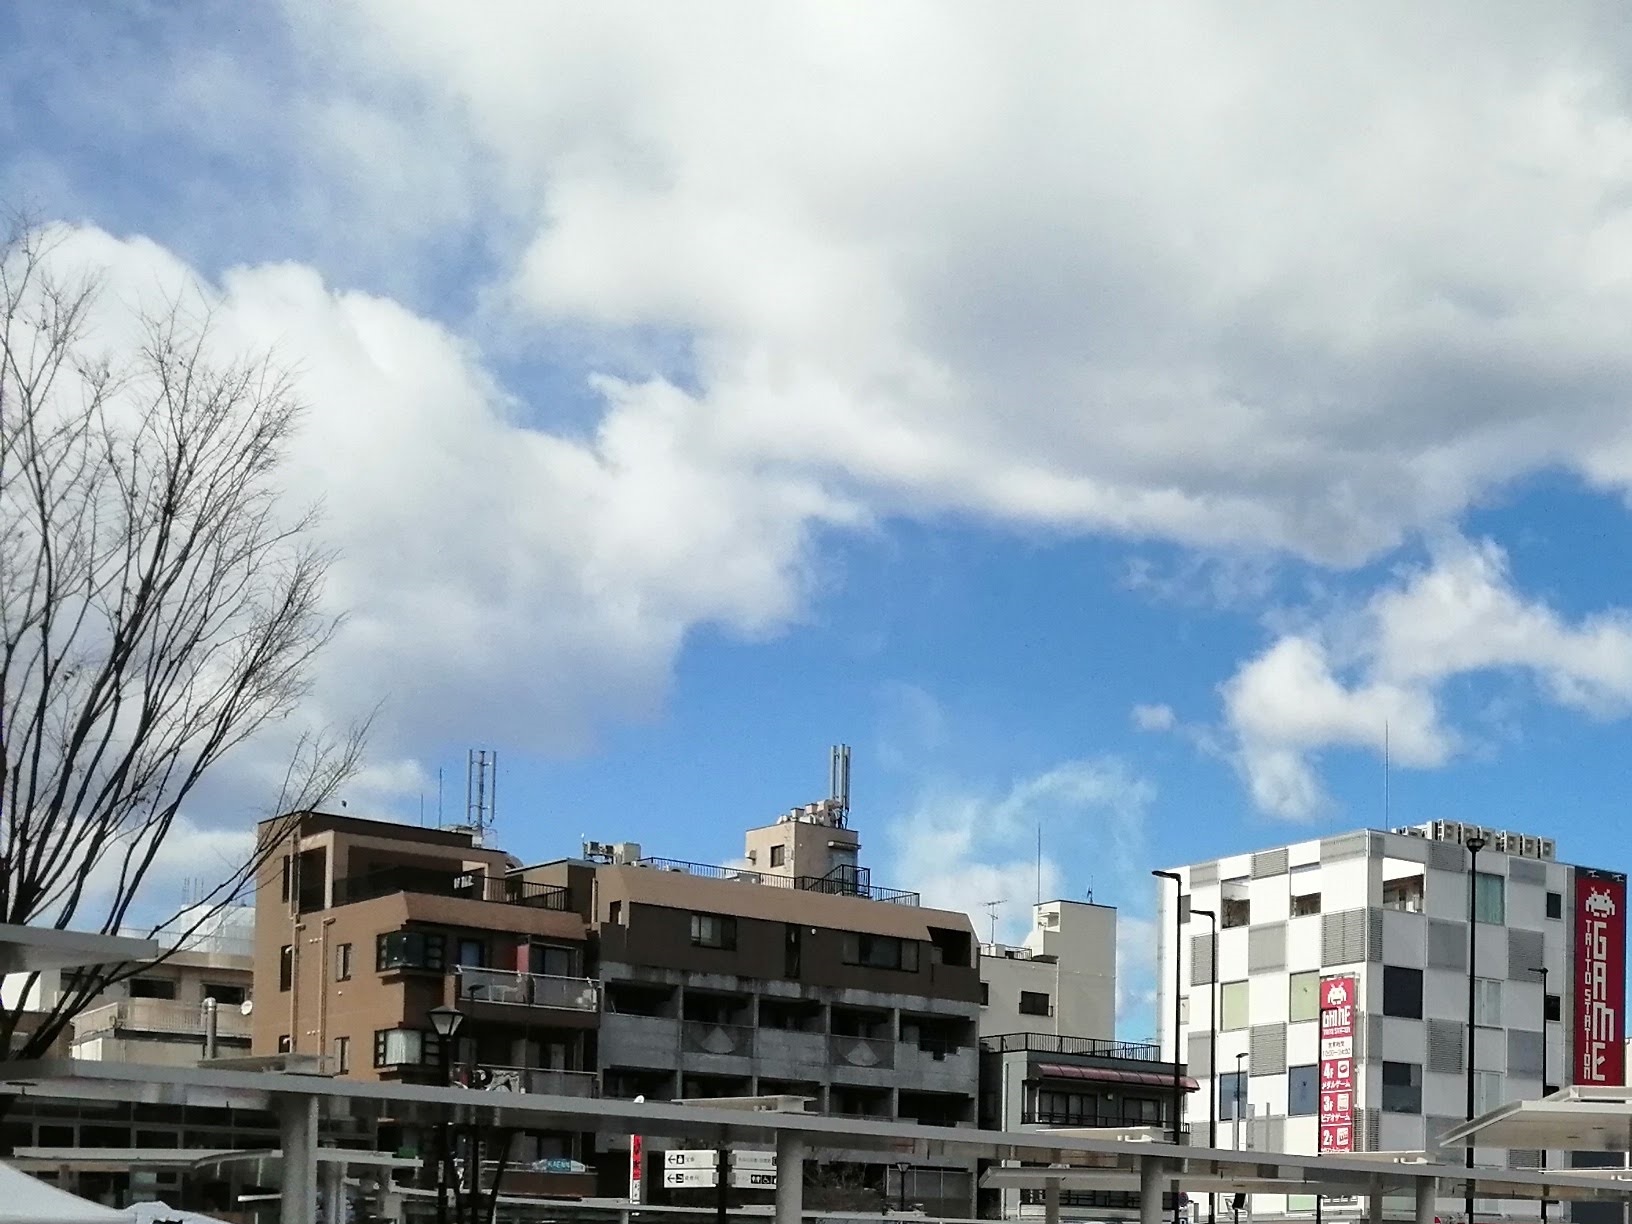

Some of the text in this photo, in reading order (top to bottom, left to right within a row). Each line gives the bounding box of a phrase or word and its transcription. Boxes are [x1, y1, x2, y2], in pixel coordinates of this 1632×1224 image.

[1583, 988, 1592, 1080] STATION
[1592, 920, 1614, 1081] GAME
[1323, 1095, 1334, 1112] 3F
